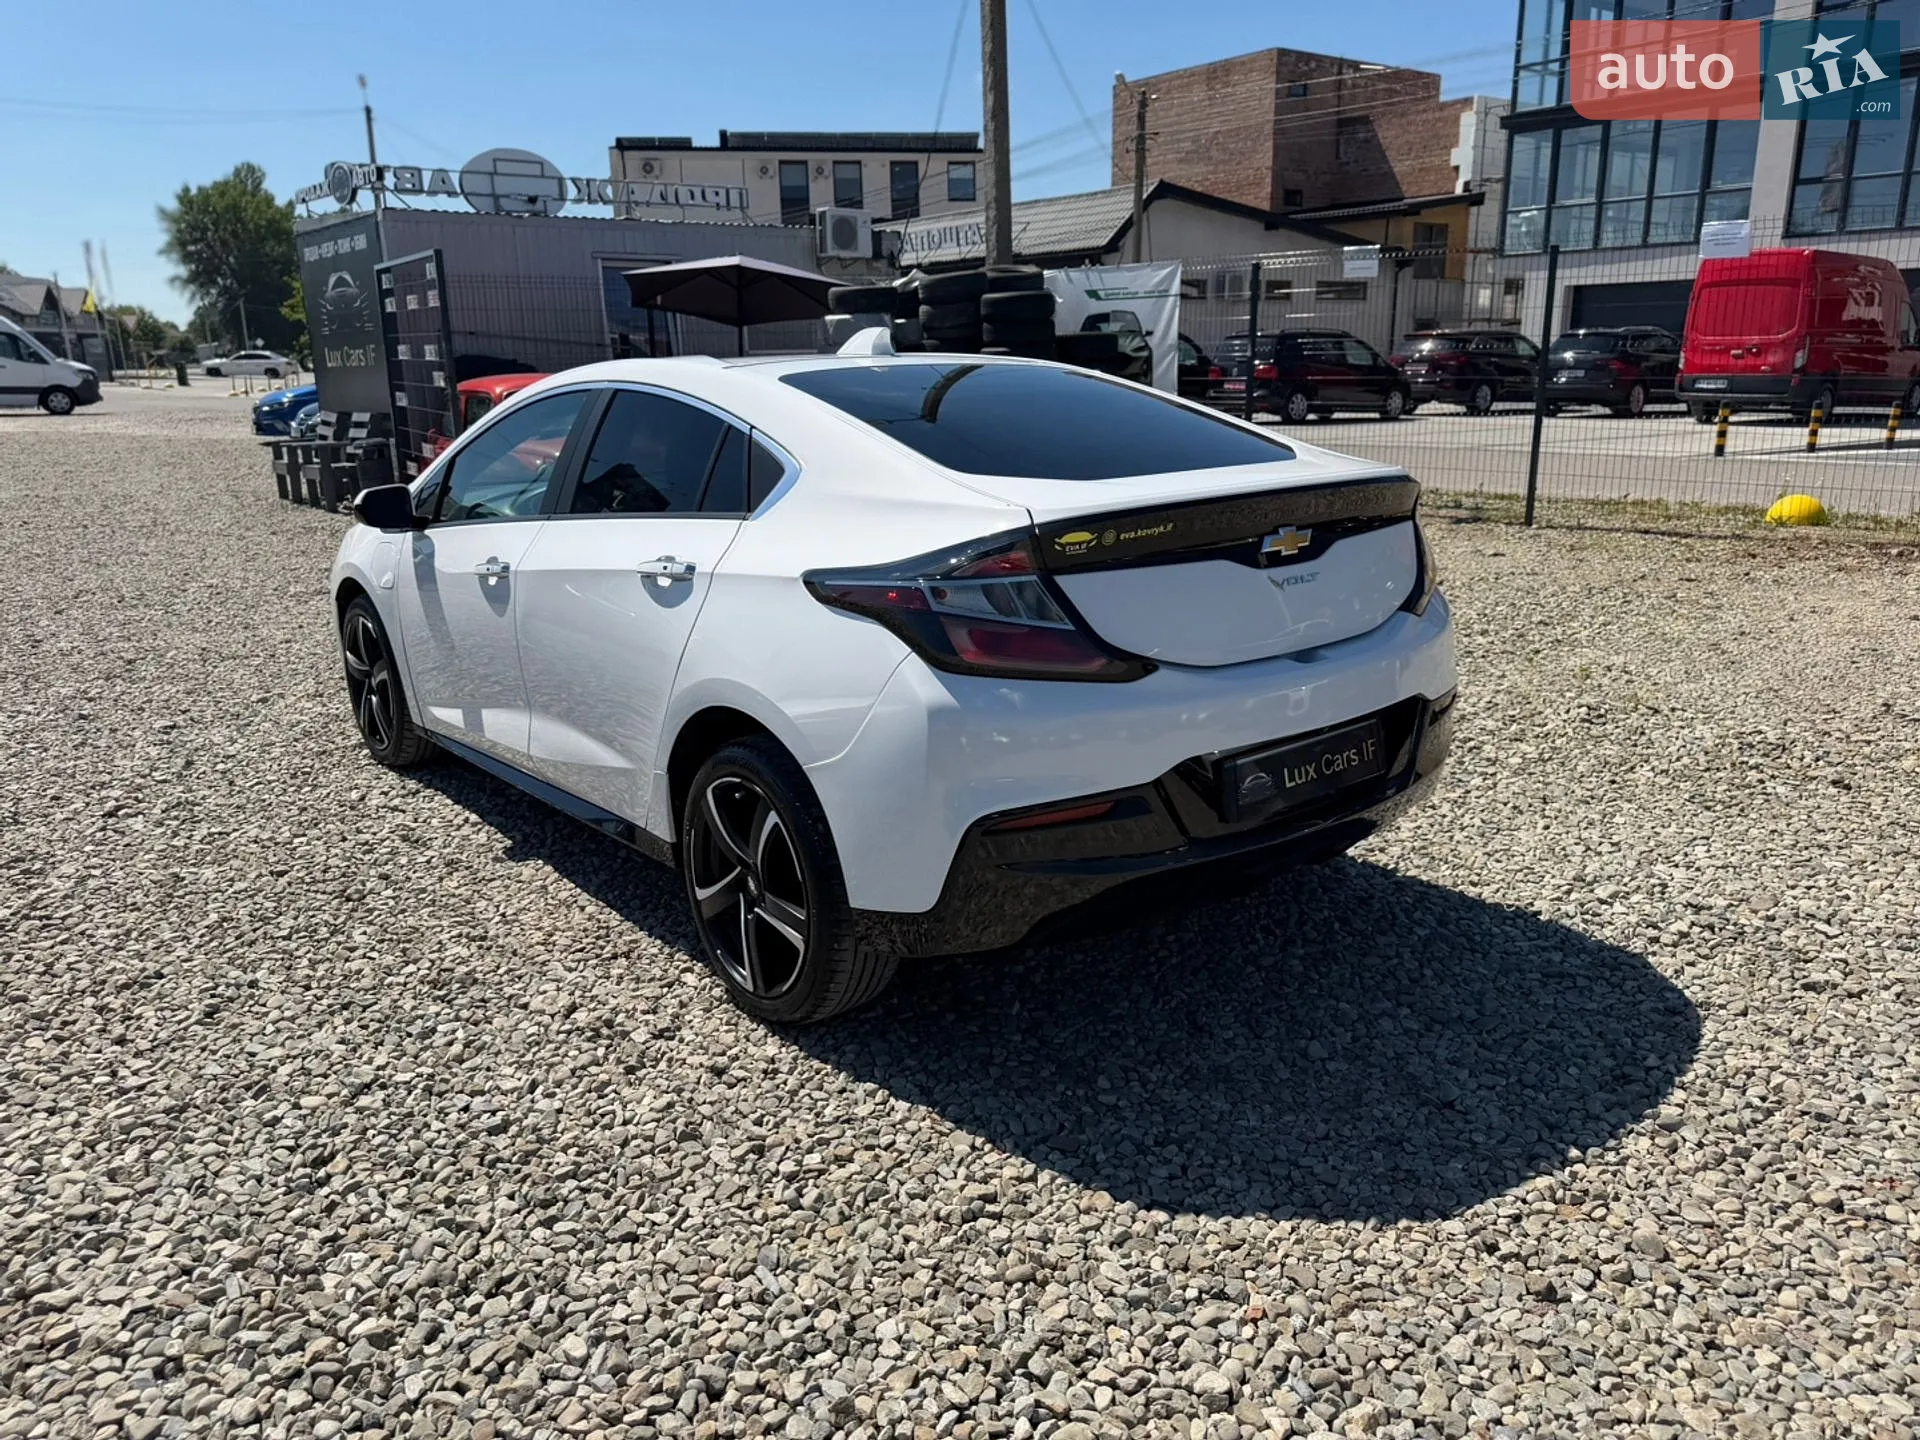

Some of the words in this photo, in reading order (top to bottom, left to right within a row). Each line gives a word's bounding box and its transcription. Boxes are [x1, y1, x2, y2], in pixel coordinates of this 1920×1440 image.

[324, 346, 343, 368] Lux
[343, 345, 366, 367] Cars
[1267, 571, 1321, 593] VOLT
[1283, 761, 1318, 789] Lux
[1321, 748, 1360, 775] Cars
[1362, 738, 1377, 761] IF
